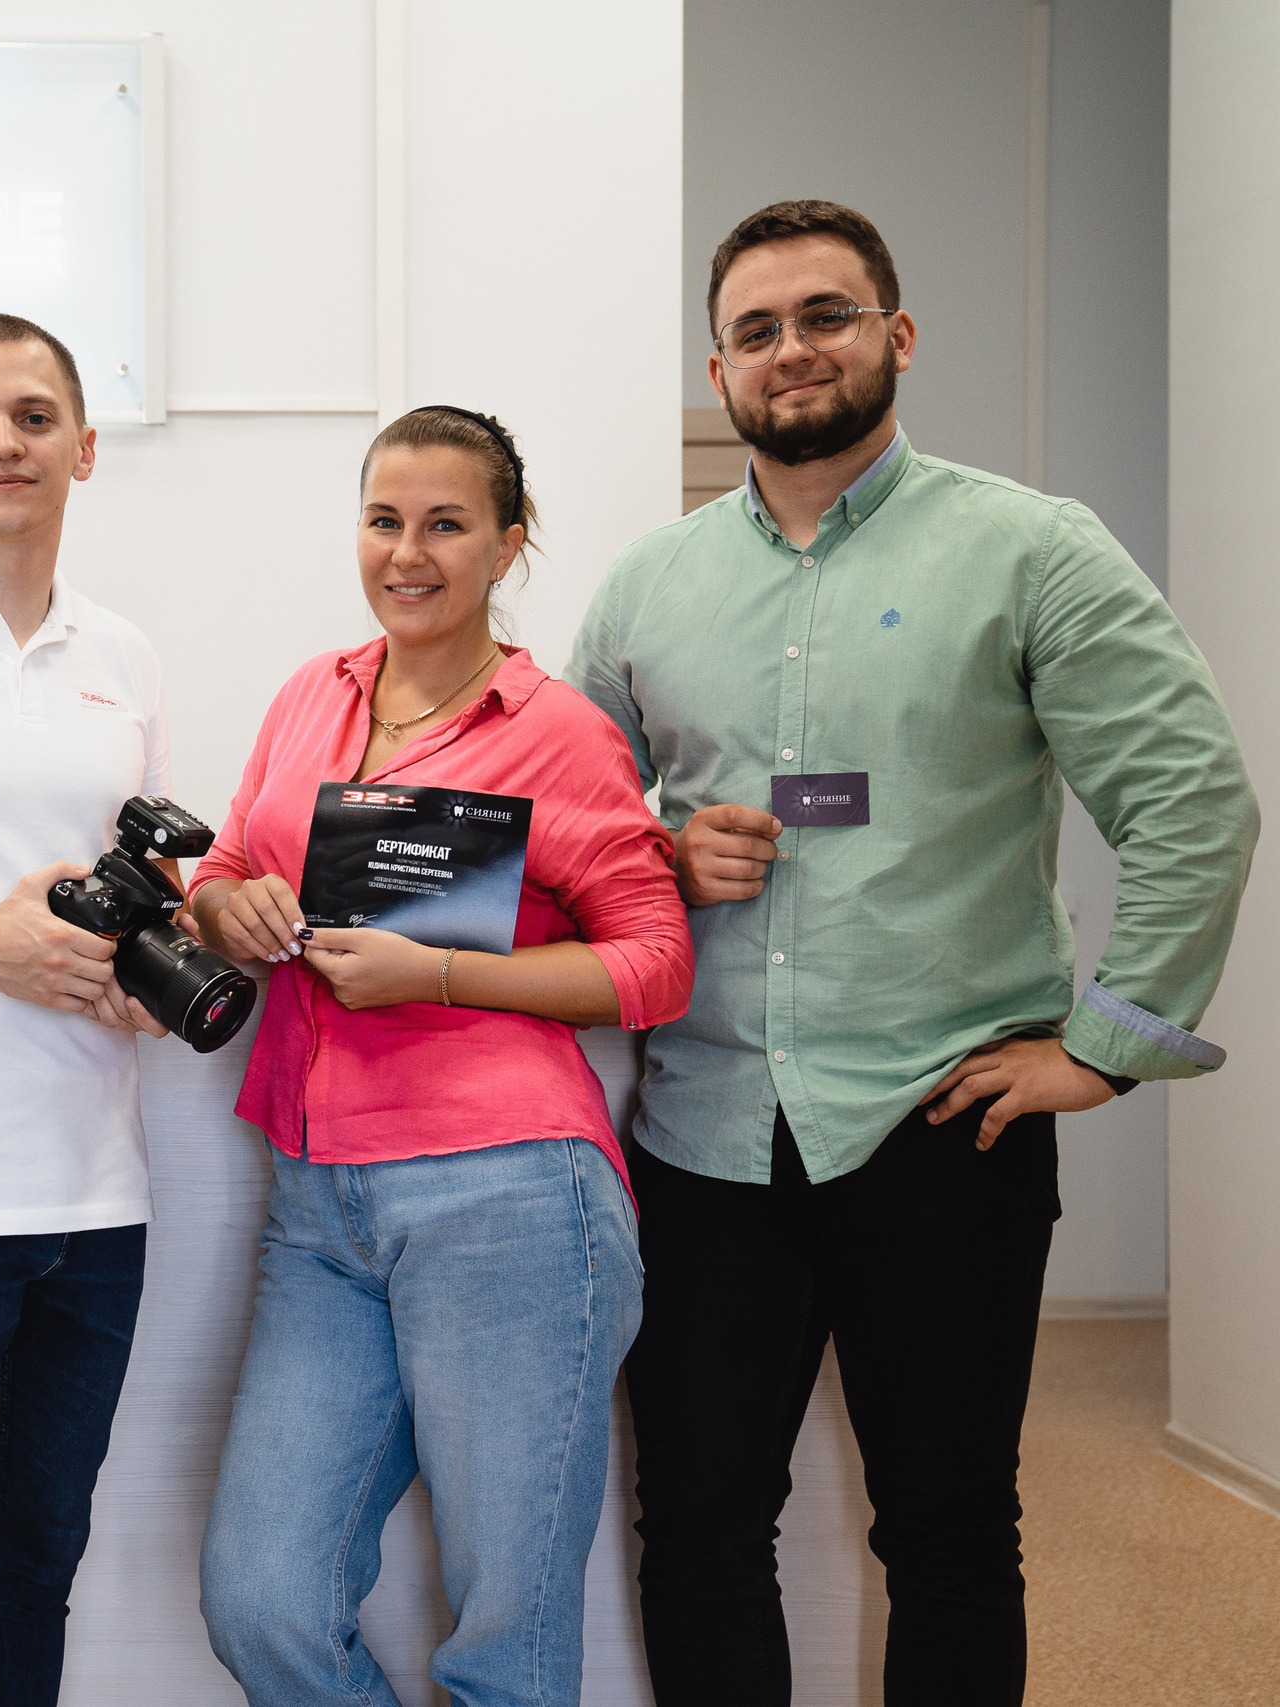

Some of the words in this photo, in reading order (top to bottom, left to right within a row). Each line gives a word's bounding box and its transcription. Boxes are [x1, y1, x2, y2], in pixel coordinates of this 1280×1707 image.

[342, 790, 415, 805] 32+
[812, 794, 851, 803] СИЯНИЕ
[465, 807, 512, 821] СИЯНИЕ
[376, 839, 452, 860] СЕРТИФИКАТ
[367, 861, 390, 871] ЮДИНА
[390, 864, 420, 875] КРИСТИНА
[421, 867, 453, 879] СЕРГЕЕВНА
[161, 900, 183, 909] Nikon
